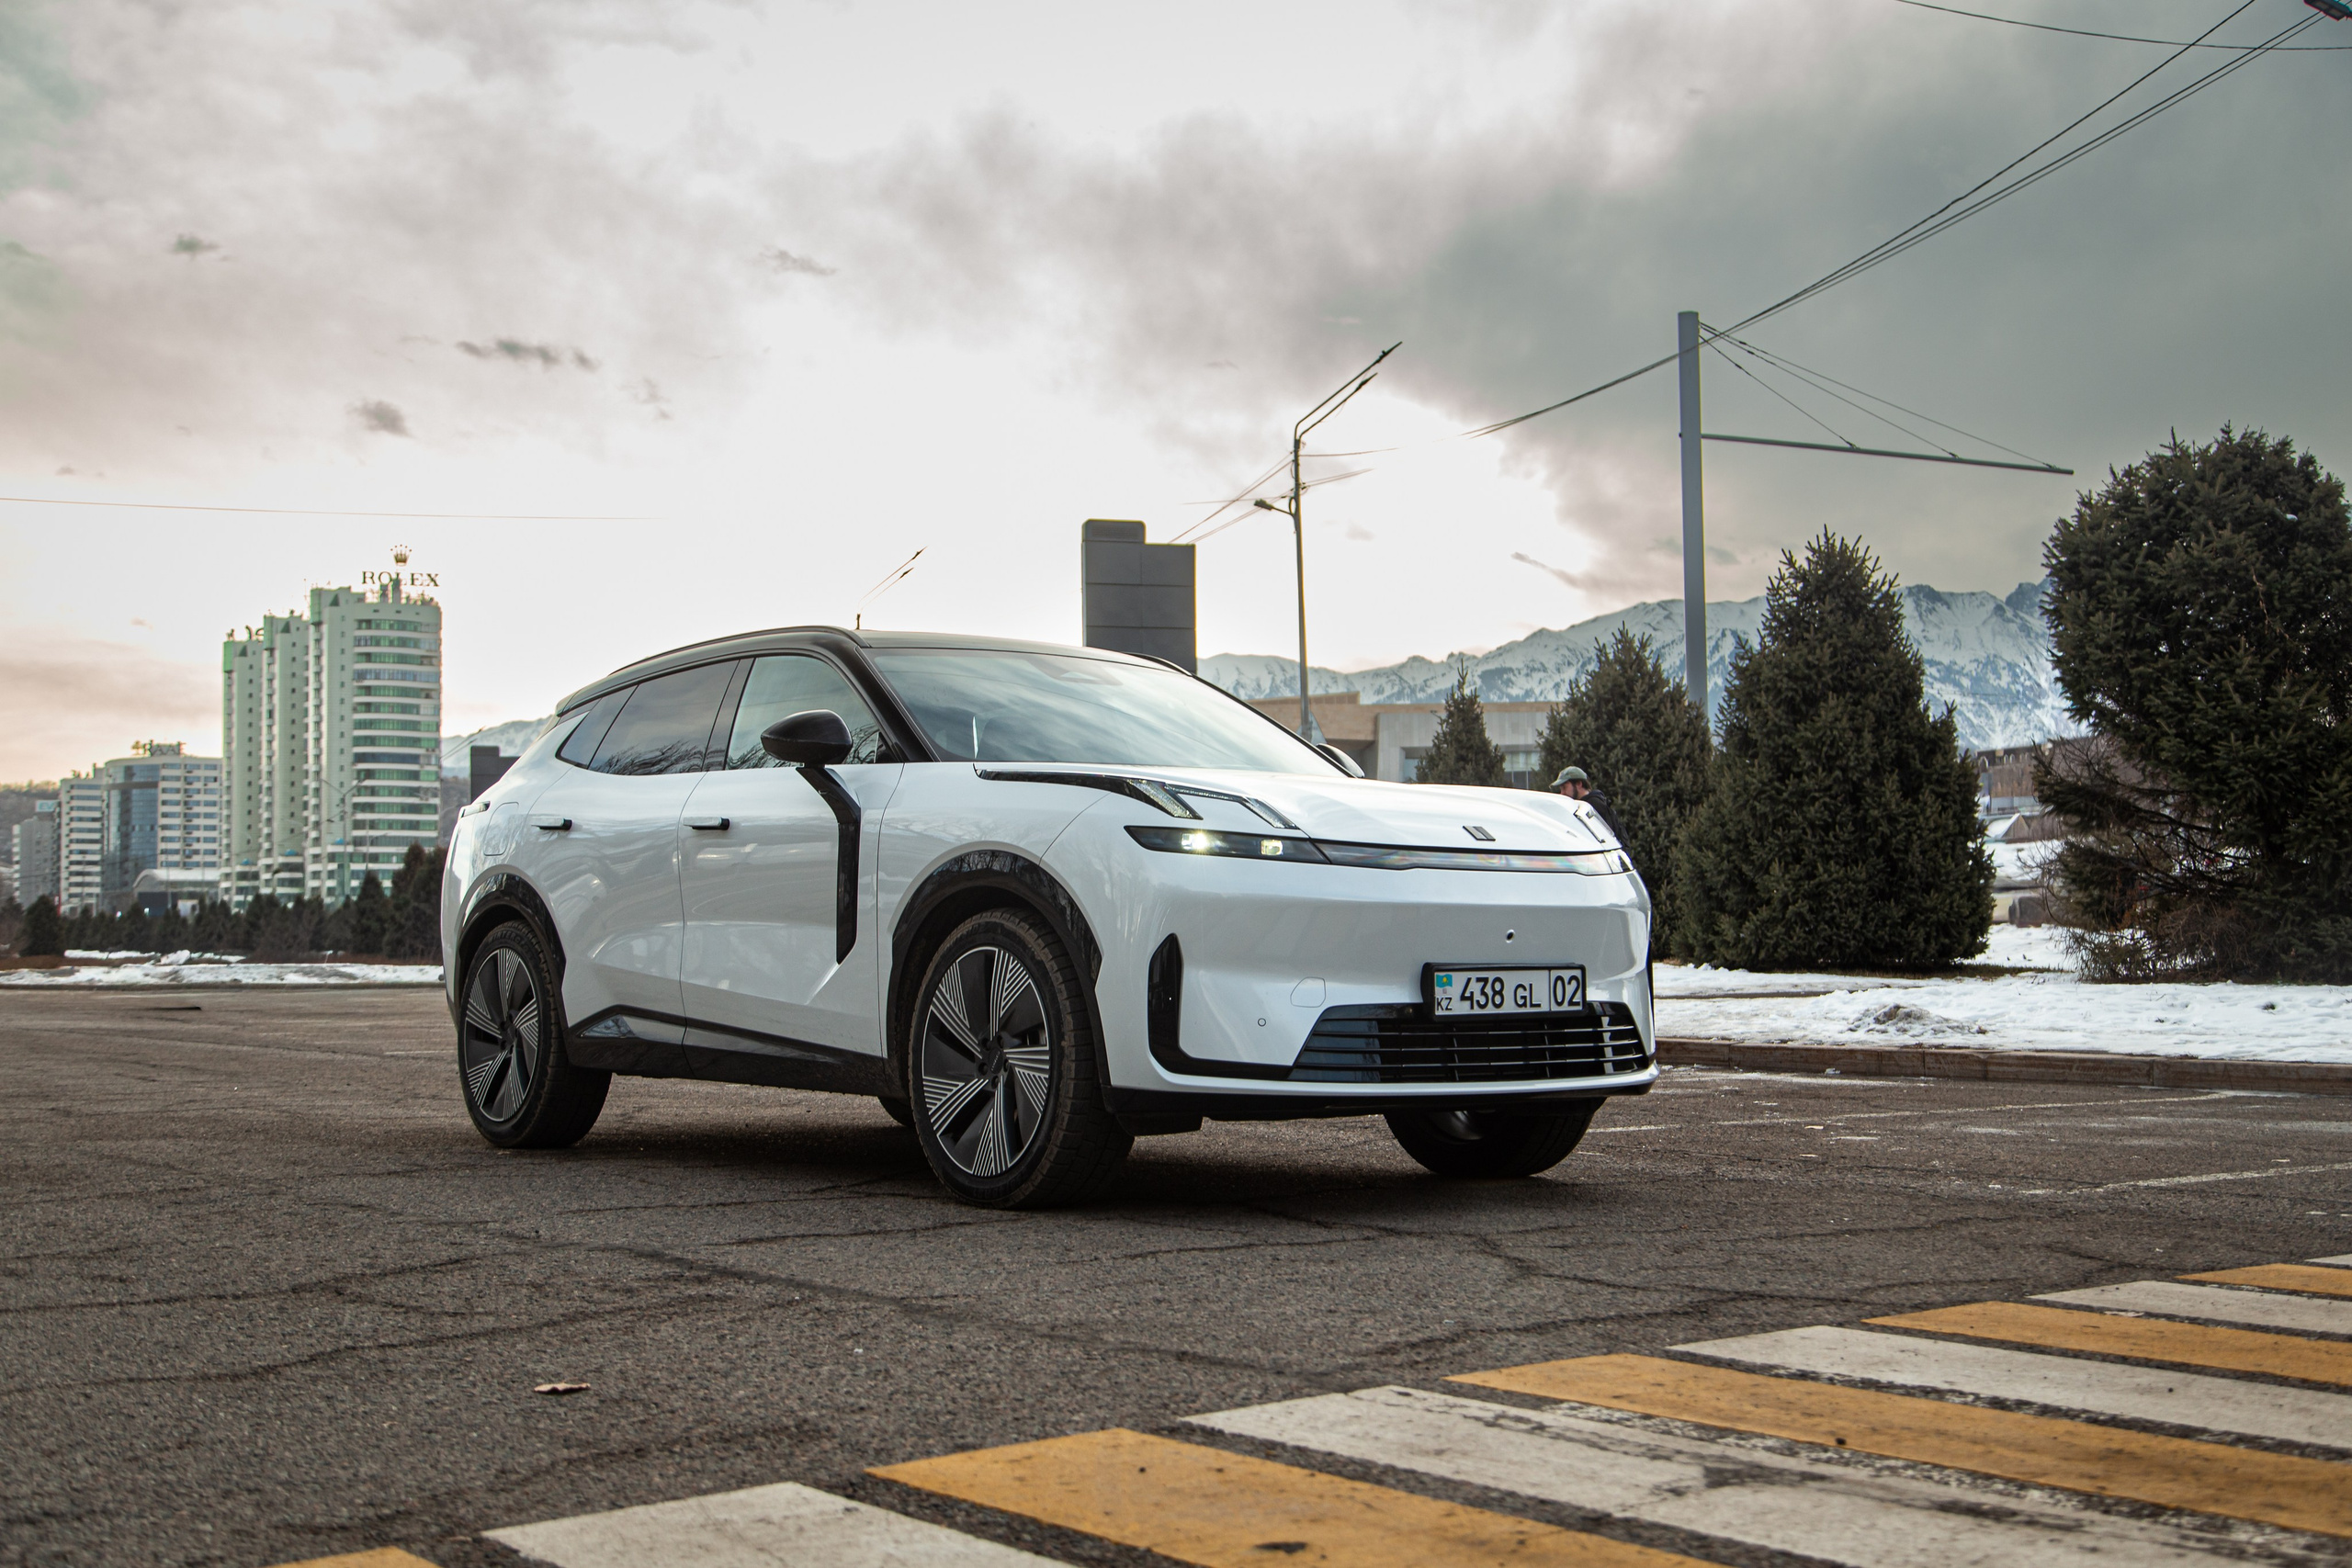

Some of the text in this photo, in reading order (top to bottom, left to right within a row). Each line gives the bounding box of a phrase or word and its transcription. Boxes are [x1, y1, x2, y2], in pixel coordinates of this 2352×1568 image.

[362, 571, 439, 587] ROLEX
[1460, 975, 1581, 1010] 438 GL 02
[1436, 997, 1453, 1010] KZ
